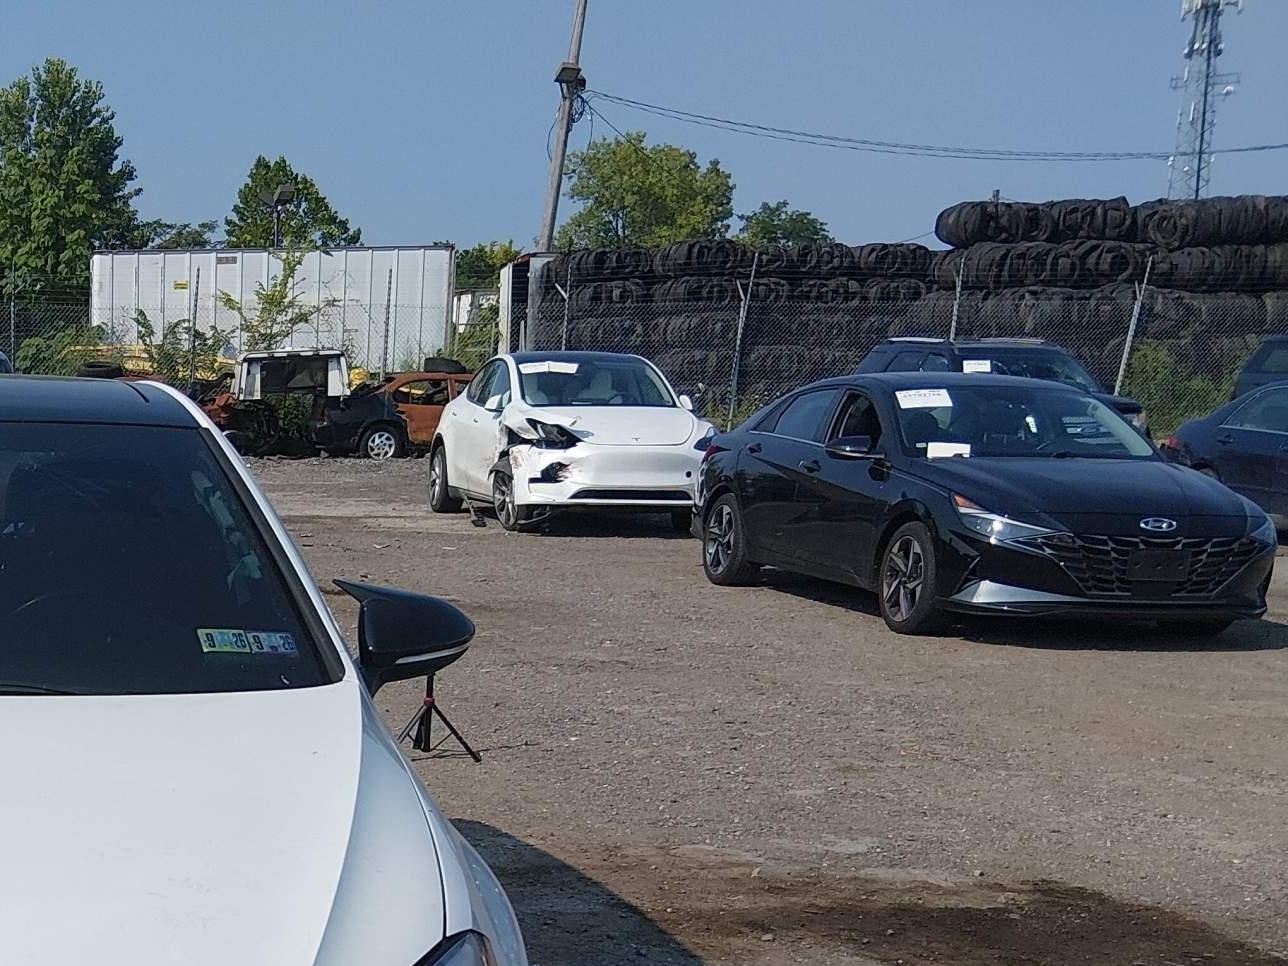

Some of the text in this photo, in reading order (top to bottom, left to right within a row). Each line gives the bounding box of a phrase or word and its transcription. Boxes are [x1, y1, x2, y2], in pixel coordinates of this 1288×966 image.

[205, 632, 247, 649] 9 26
[252, 634, 264, 650] 9
